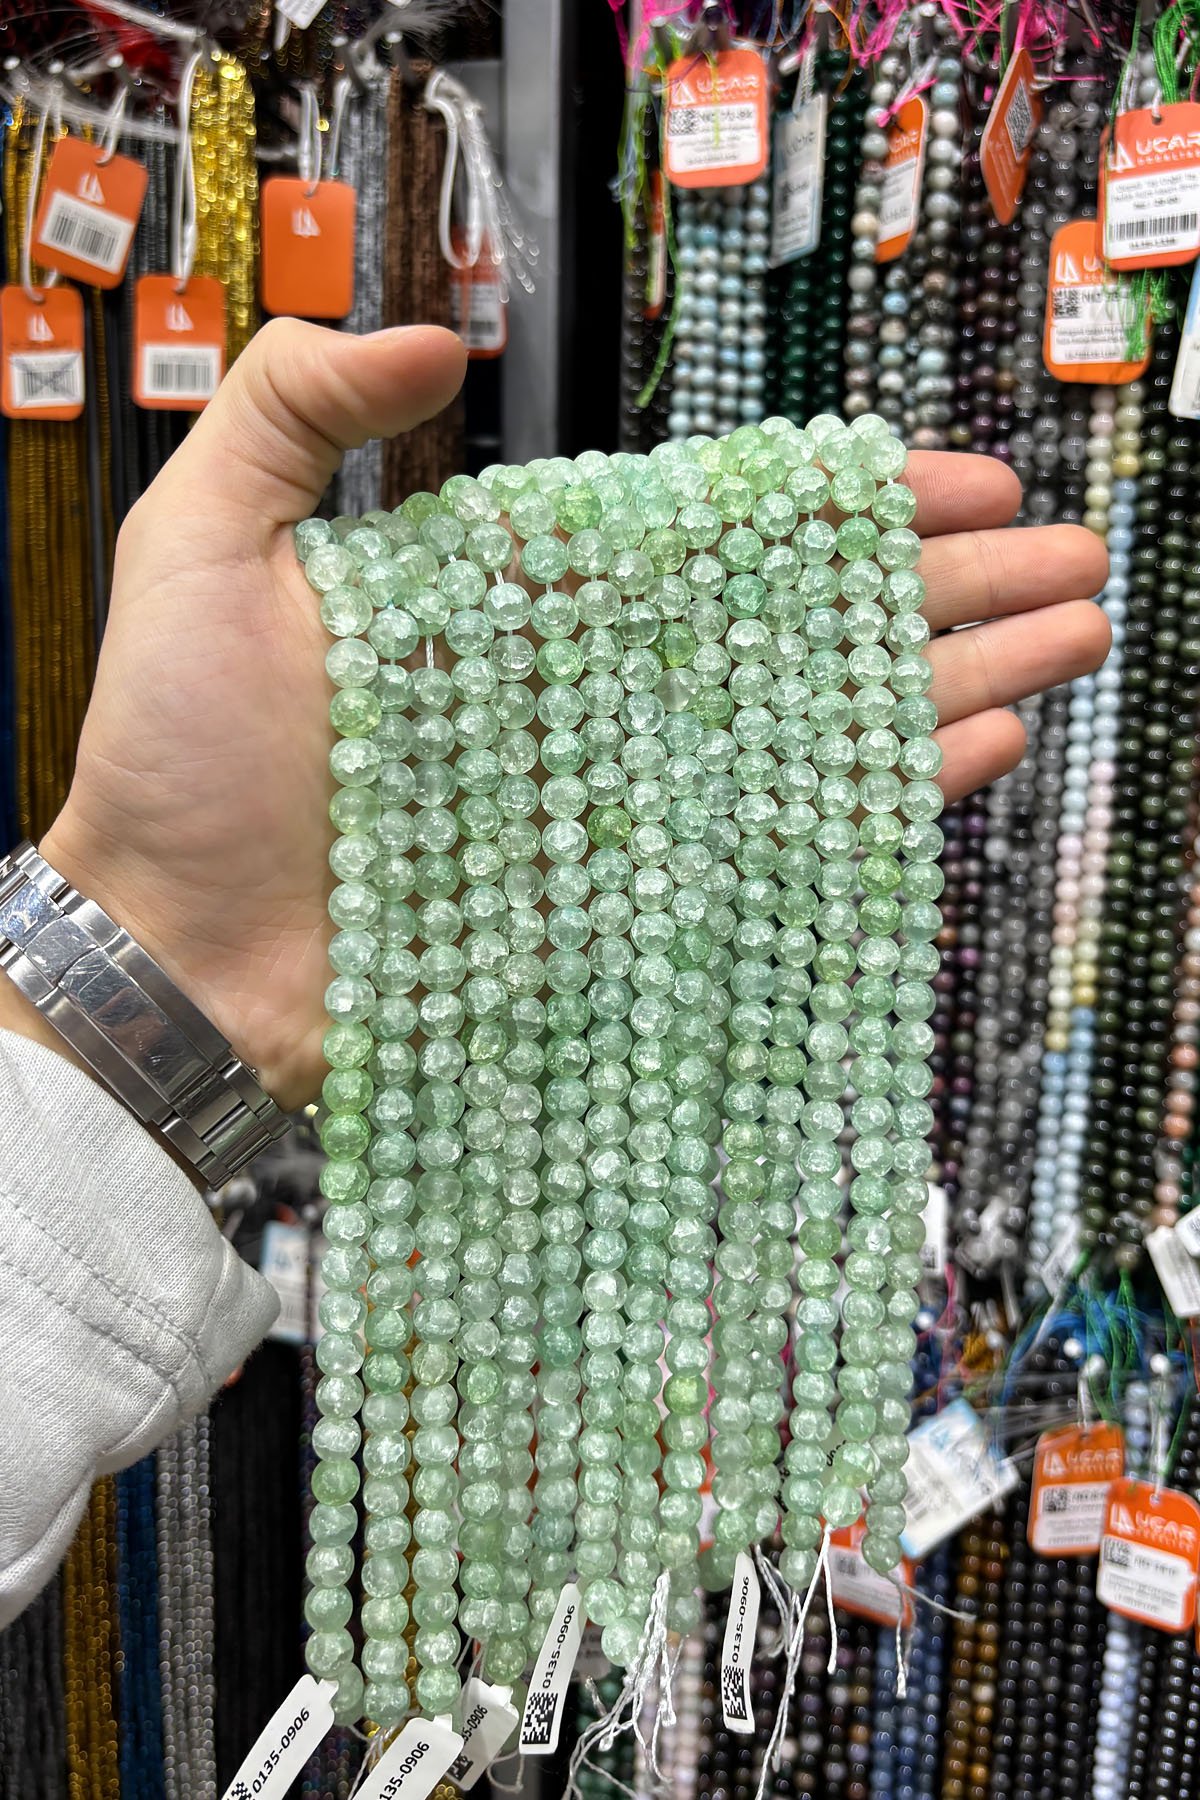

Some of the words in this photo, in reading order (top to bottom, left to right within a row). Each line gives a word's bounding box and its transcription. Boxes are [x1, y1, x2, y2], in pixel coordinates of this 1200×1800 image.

[542, 1604, 576, 1690] 0135-0906
[732, 1576, 750, 1664] 0135-0906
[252, 1707, 310, 1794] 0135-0906
[461, 1704, 489, 1744] 35-0906
